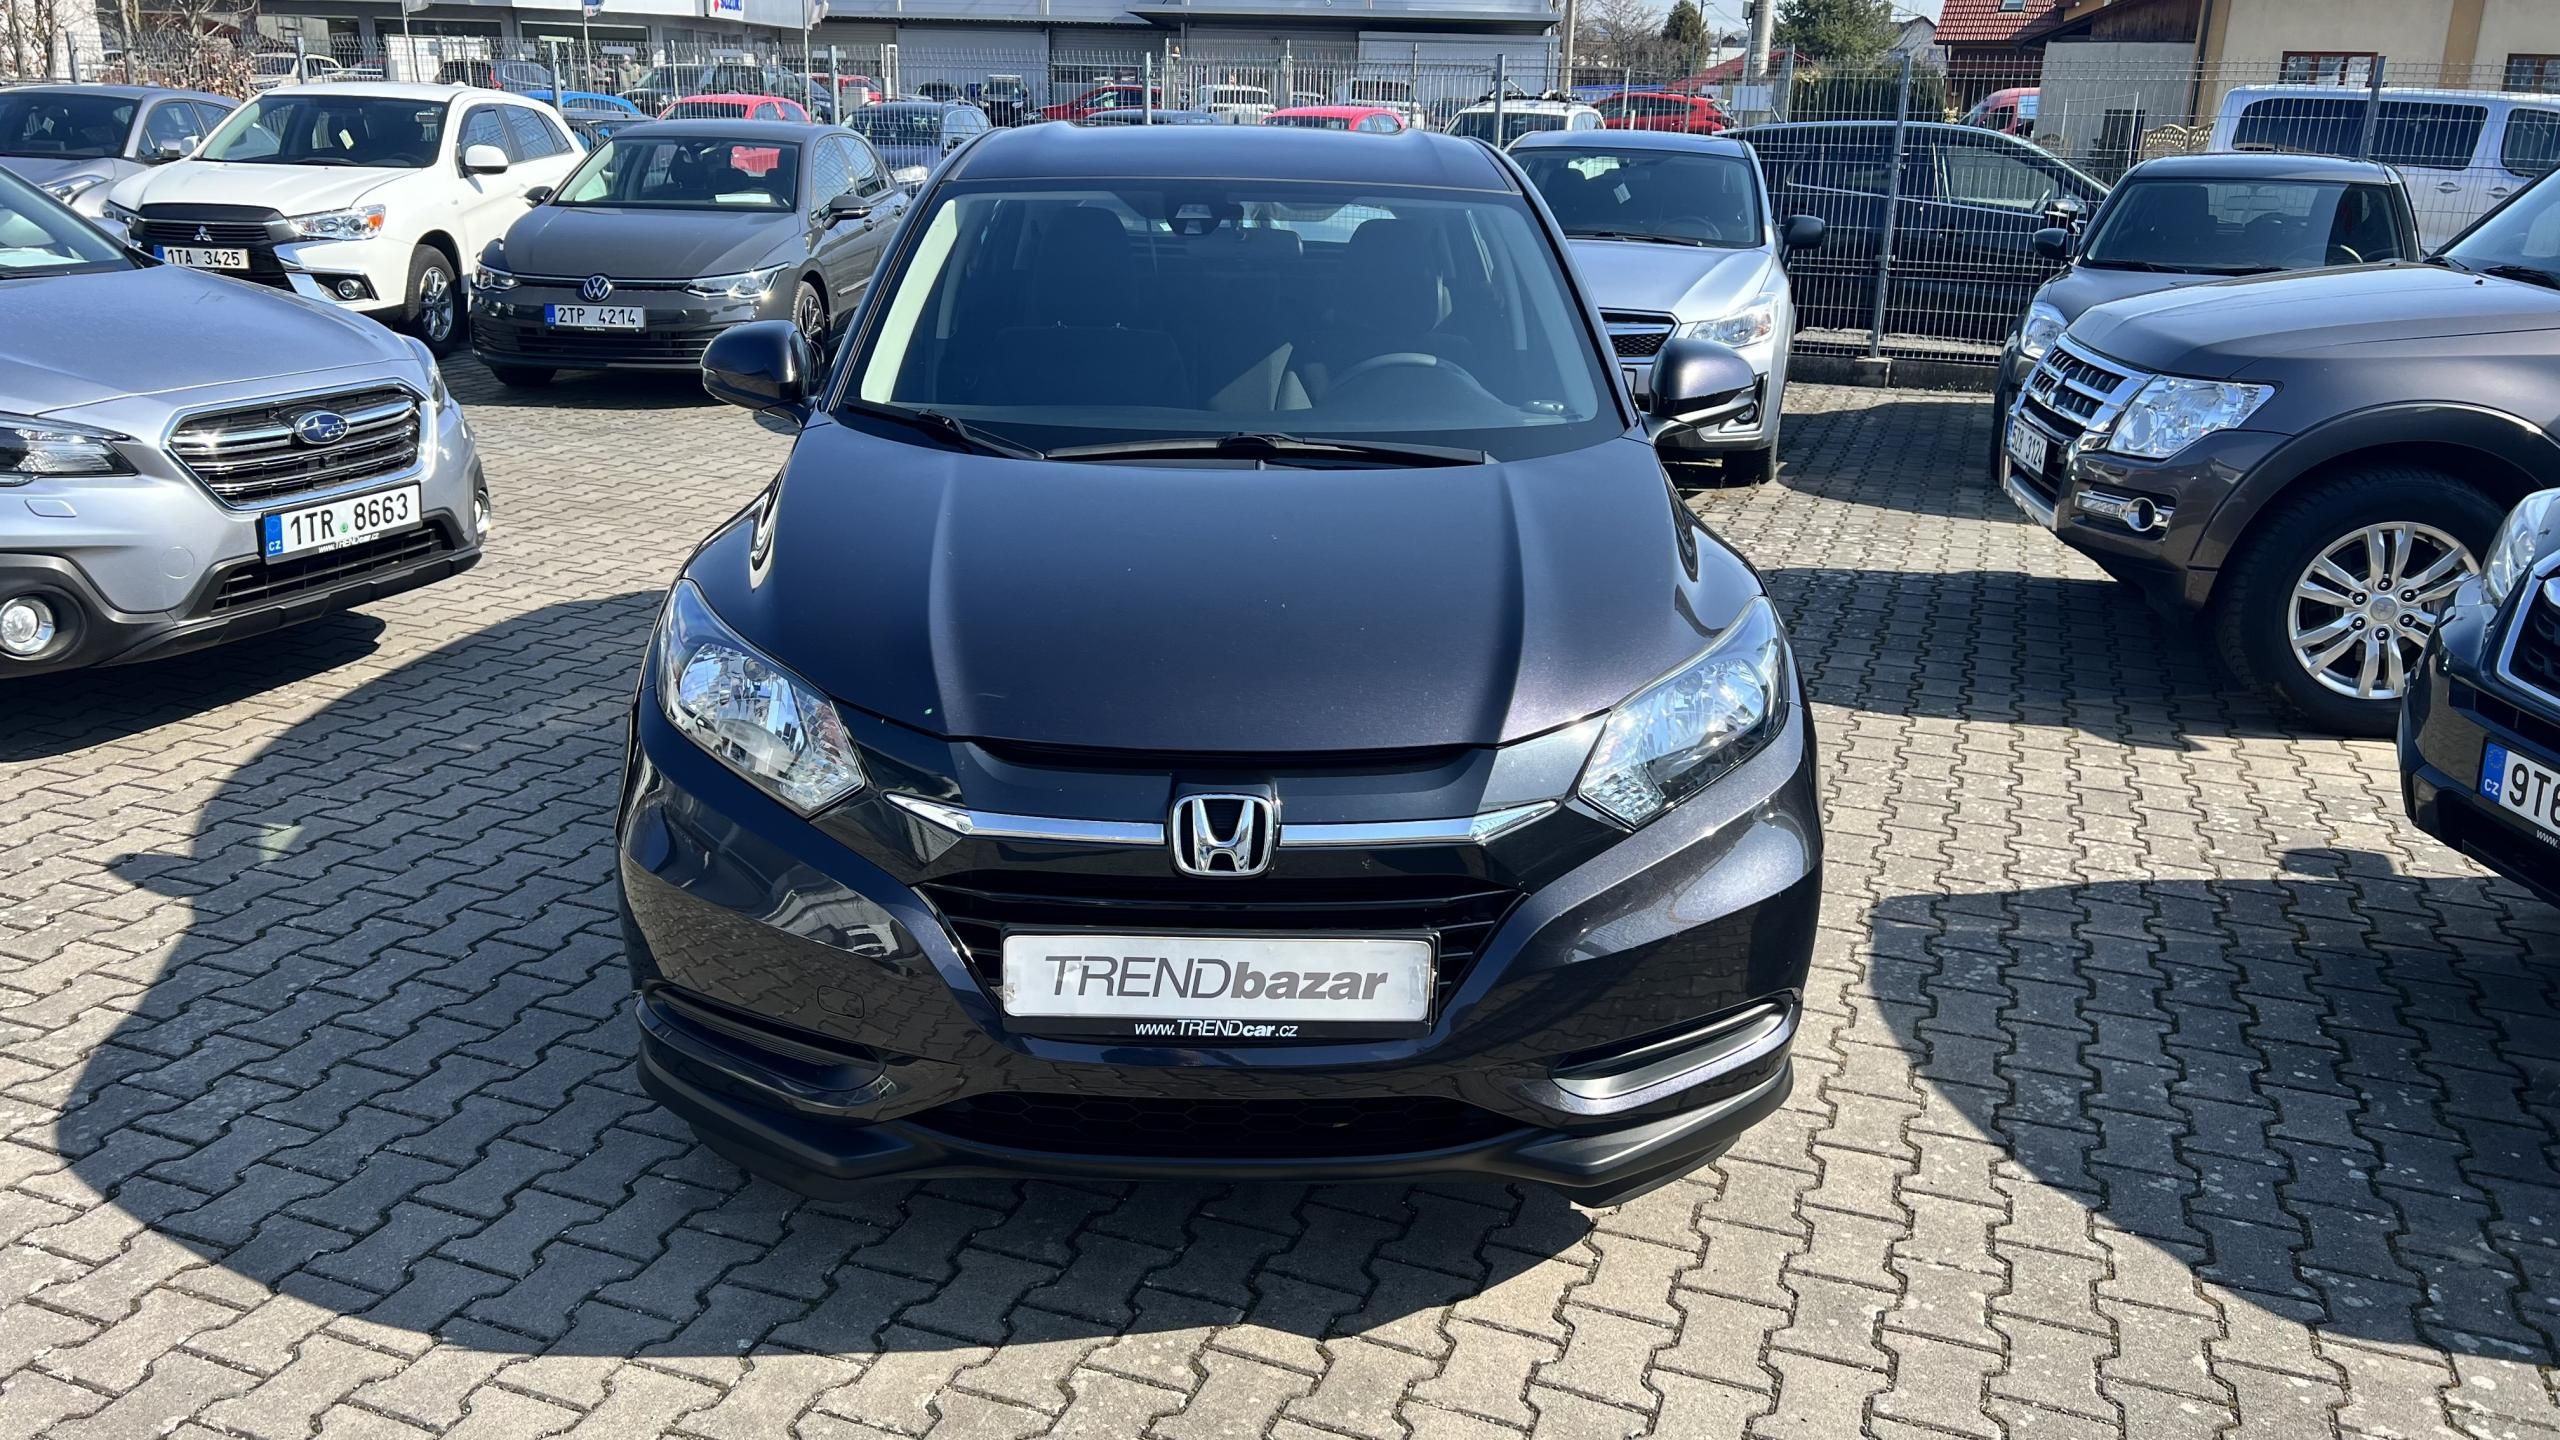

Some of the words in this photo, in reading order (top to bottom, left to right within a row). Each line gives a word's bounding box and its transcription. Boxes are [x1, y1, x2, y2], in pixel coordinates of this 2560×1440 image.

[168, 249, 193, 265] 1TA
[204, 250, 240, 266] 3425
[558, 307, 585, 323] 2TP
[598, 308, 636, 325] 4214
[290, 509, 335, 546] 1TR
[354, 492, 408, 531] 8663
[268, 539, 283, 552] CZ
[2484, 778, 2500, 796] CZ
[1045, 955, 1388, 1000] TRENDbazar
[1134, 1019, 1299, 1037] www.TRENDcar.cz
